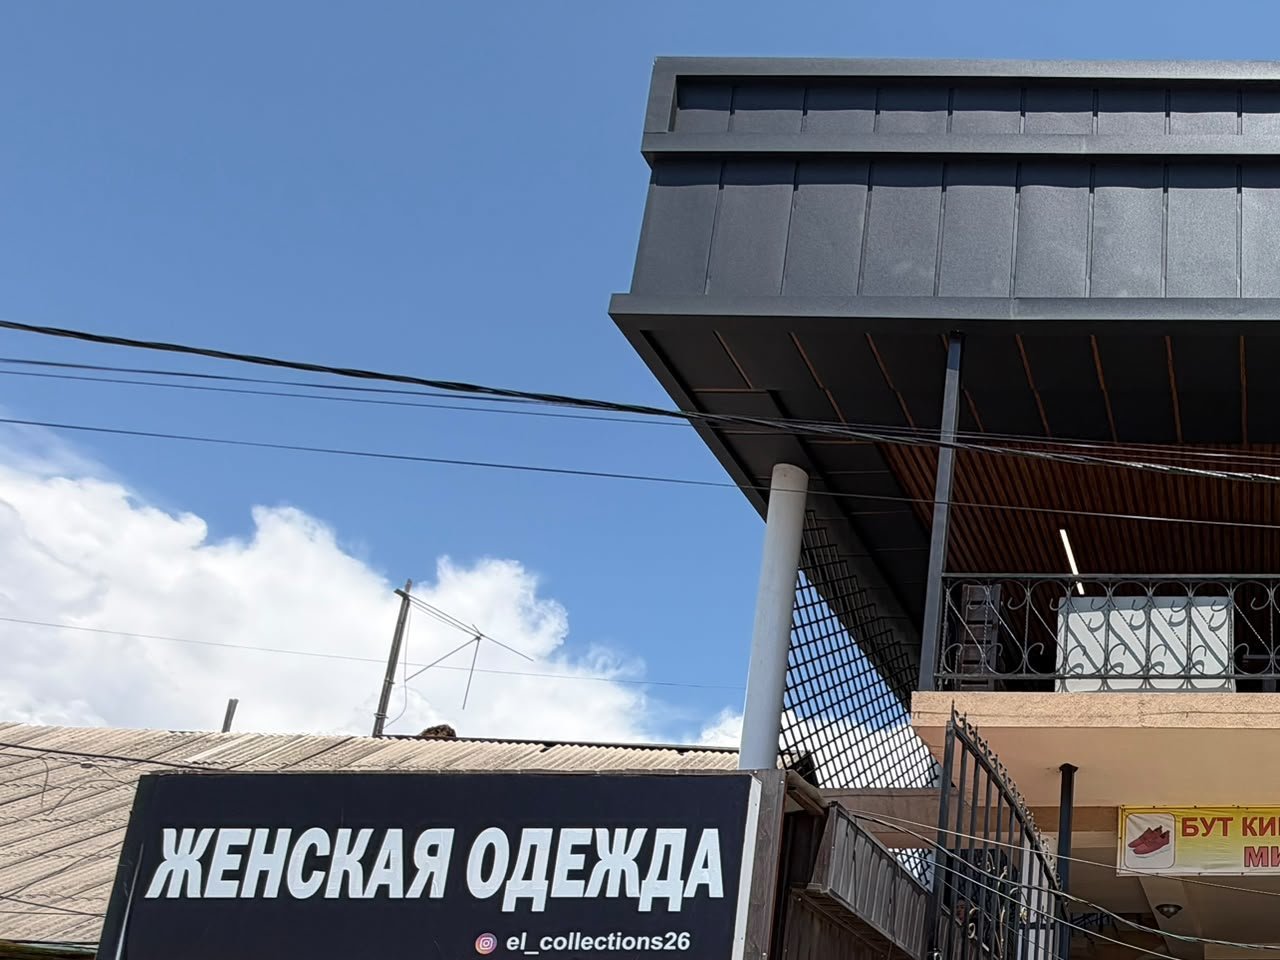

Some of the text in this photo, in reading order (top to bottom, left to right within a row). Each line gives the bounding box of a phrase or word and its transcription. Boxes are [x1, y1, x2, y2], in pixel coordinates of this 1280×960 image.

[1181, 817, 1234, 837] БУТ
[144, 827, 724, 912] ЖЕНСКАЯ ОДЕЖДА
[505, 932, 690, 955] el_collections26
